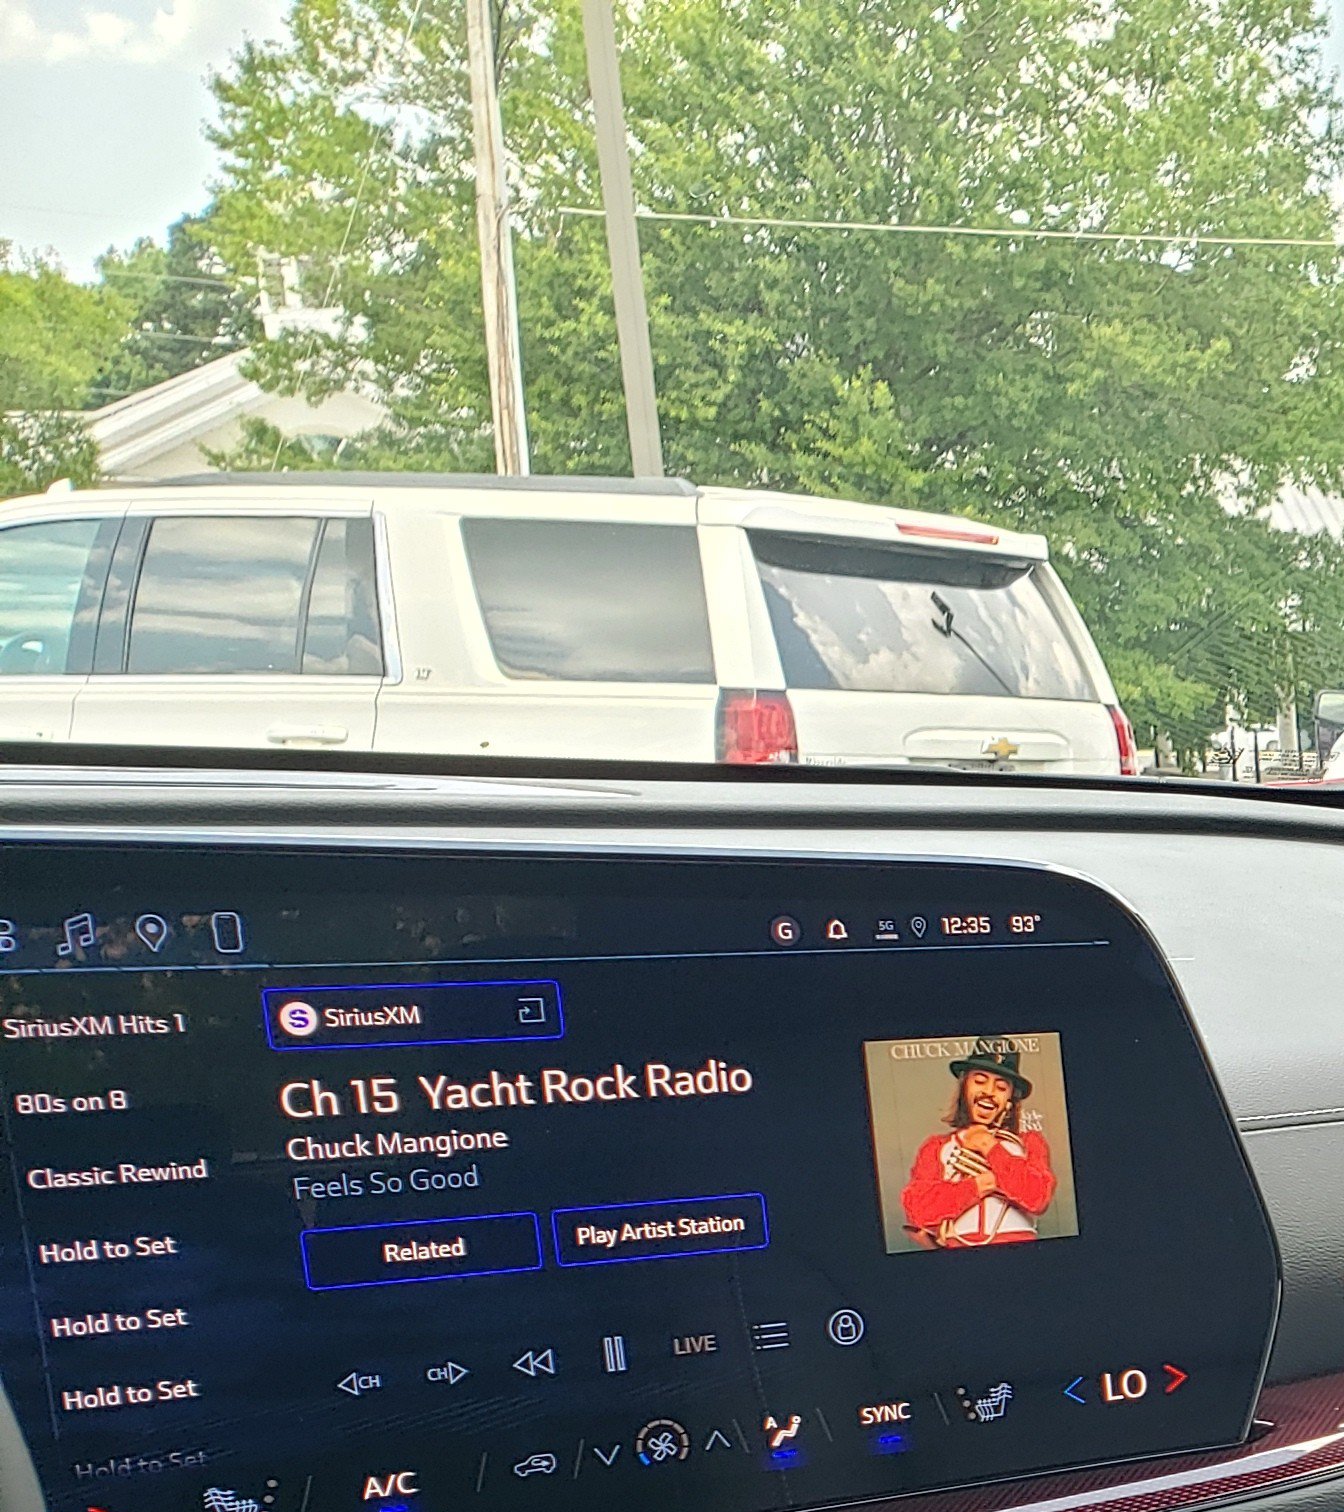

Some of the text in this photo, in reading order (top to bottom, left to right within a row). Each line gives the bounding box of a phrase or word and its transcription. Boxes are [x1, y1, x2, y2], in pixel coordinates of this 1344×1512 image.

[777, 914, 1041, 940] G 5G 12:35 93°
[2, 1013, 187, 1039] SiriusXM Hits 1
[323, 1004, 421, 1028] SiriusXM
[891, 1037, 1040, 1060] CHUCK MANGIONE
[15, 1089, 128, 1115] 80s on 8
[279, 1058, 753, 1119] Ch 15 Yacht Rock Radio
[286, 1128, 511, 1161] Chuck Mangione
[27, 1158, 210, 1190] Classic Rewind
[292, 1163, 481, 1200] Feels So Good
[576, 1215, 746, 1249] Play Artist Station
[40, 1234, 178, 1265] Hold to Set
[383, 1235, 466, 1264] Related
[51, 1306, 188, 1339] Hold to Set
[673, 1334, 717, 1356] LIVE
[358, 1373, 380, 1390] CH
[426, 1366, 448, 1383] CH
[1104, 1367, 1148, 1402] LO
[63, 1377, 199, 1411] Hold to Set
[860, 1401, 912, 1426] SYNC
[75, 1450, 208, 1480] Hold to Set
[363, 1468, 421, 1500] A/C
